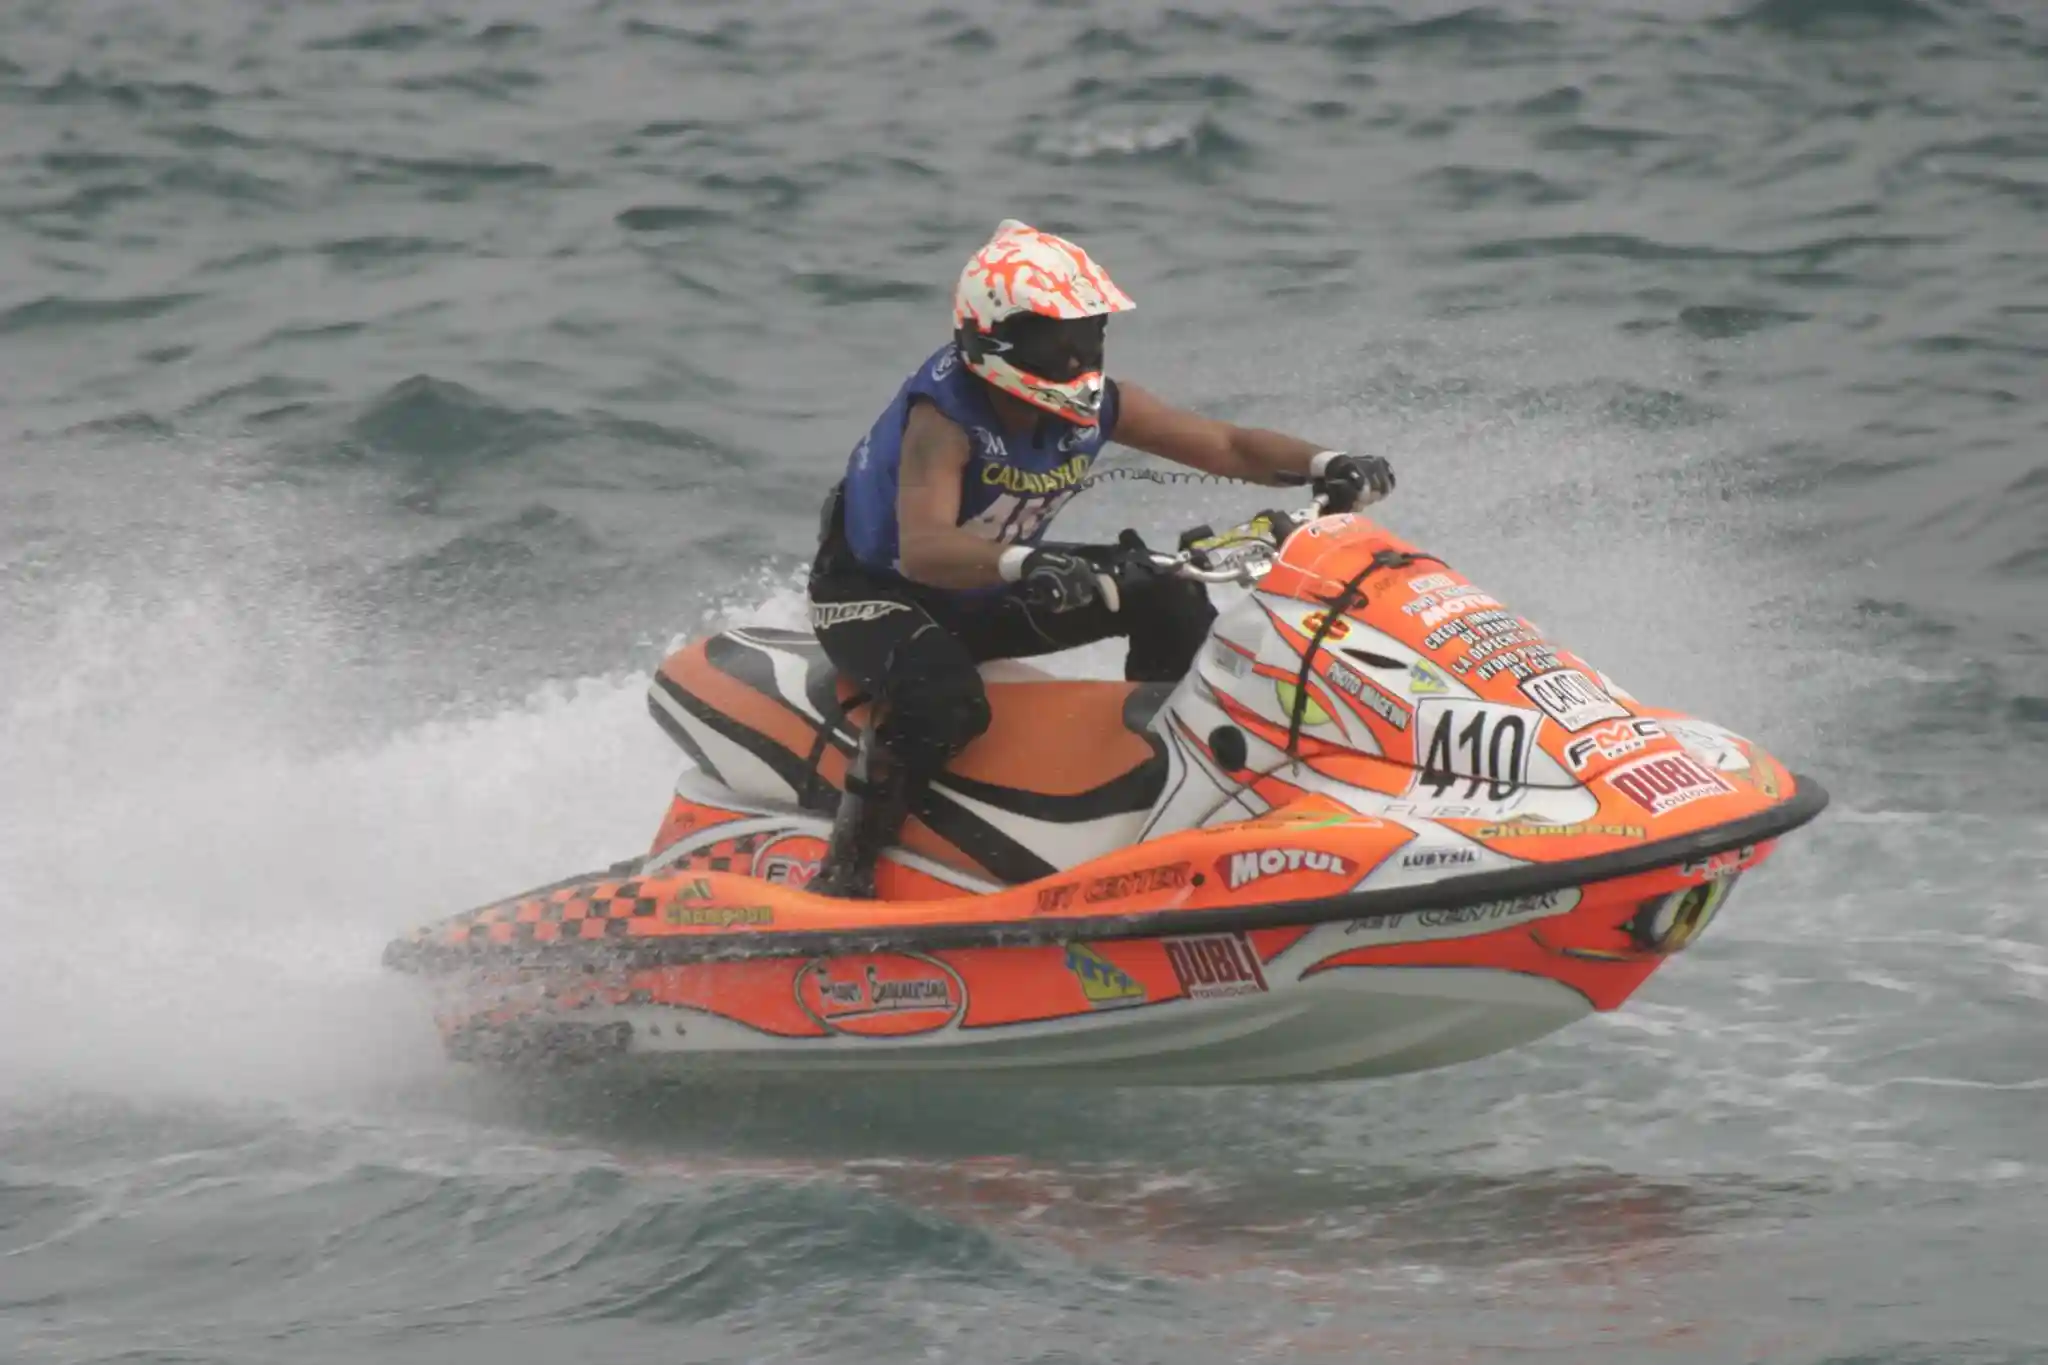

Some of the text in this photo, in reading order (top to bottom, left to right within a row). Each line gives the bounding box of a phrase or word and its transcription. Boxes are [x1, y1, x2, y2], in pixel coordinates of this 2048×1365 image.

[1418, 709, 1525, 801] 410
[1566, 719, 1661, 768] FMC
[1230, 849, 1347, 890] MOTUL
